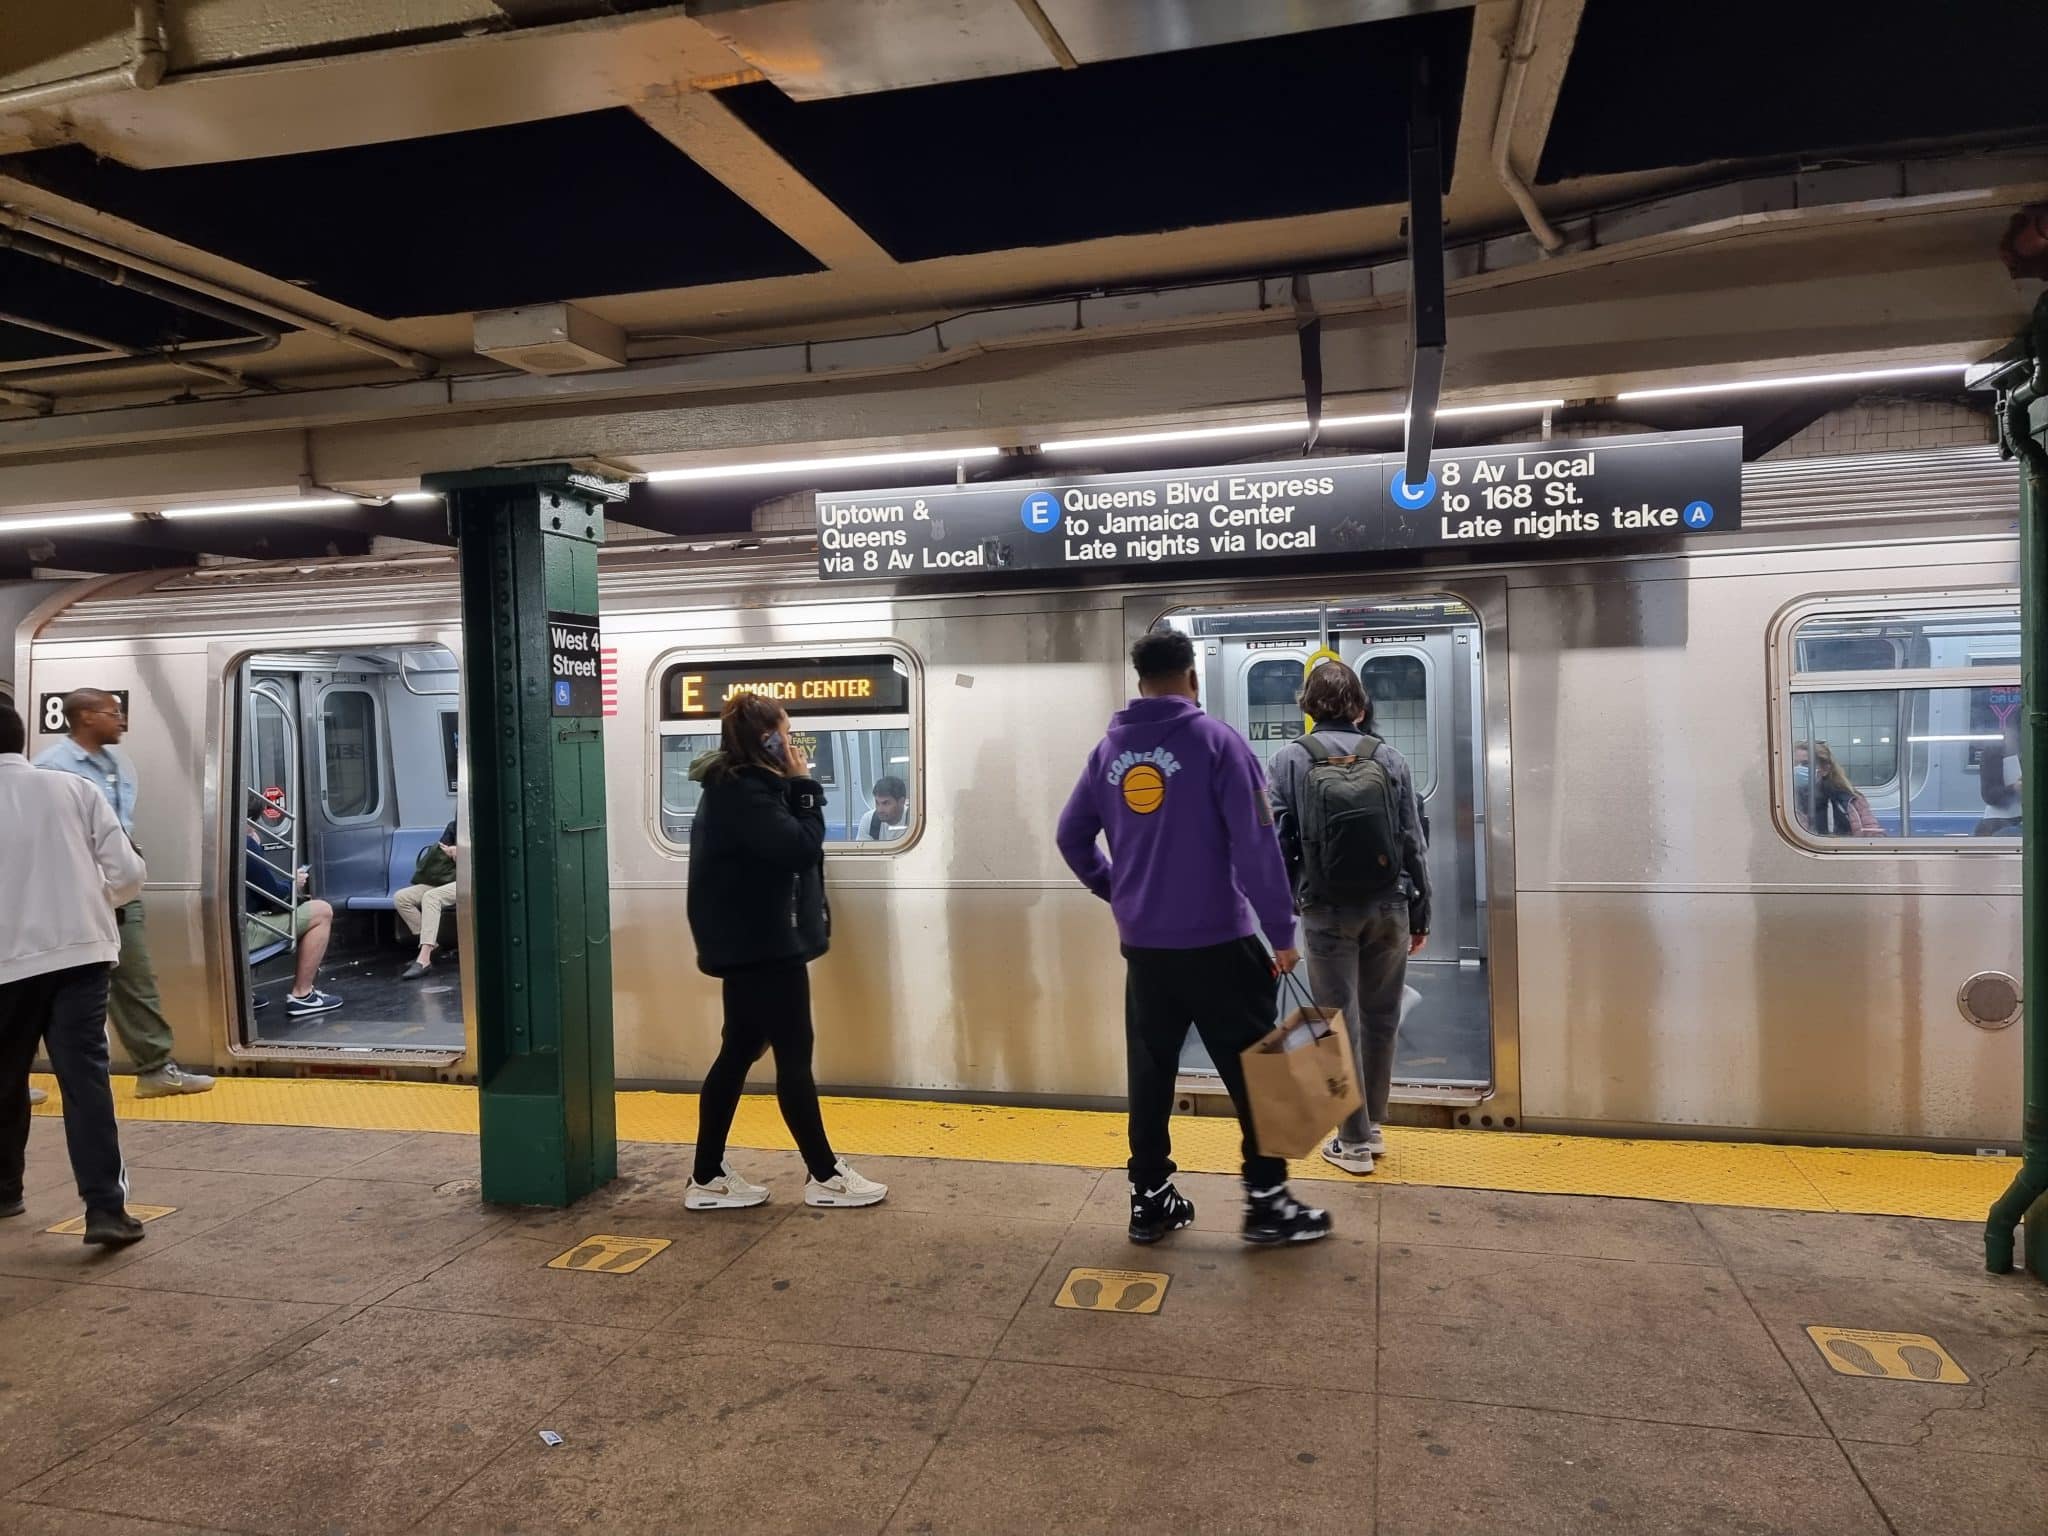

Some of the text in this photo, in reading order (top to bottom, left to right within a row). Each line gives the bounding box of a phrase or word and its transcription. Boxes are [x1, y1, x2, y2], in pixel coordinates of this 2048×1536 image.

[1441, 452, 1595, 486] 8 Av Local
[1063, 477, 1334, 512] Queens Blvd Express
[1441, 481, 1584, 513] to 168 St.
[821, 499, 930, 528] Uptown &
[1031, 501, 1049, 524] E
[1065, 504, 1295, 536] to Jamaica Center
[1441, 503, 1706, 540] Late nights take A
[822, 528, 907, 549] Queens
[1065, 525, 1316, 561] Late nights via local
[823, 545, 983, 572] via 8 Av Local
[551, 627, 600, 652] West 4
[553, 654, 597, 677] Street
[682, 676, 704, 712] E
[802, 679, 870, 699] CENTER
[1250, 722, 1300, 739] WES
